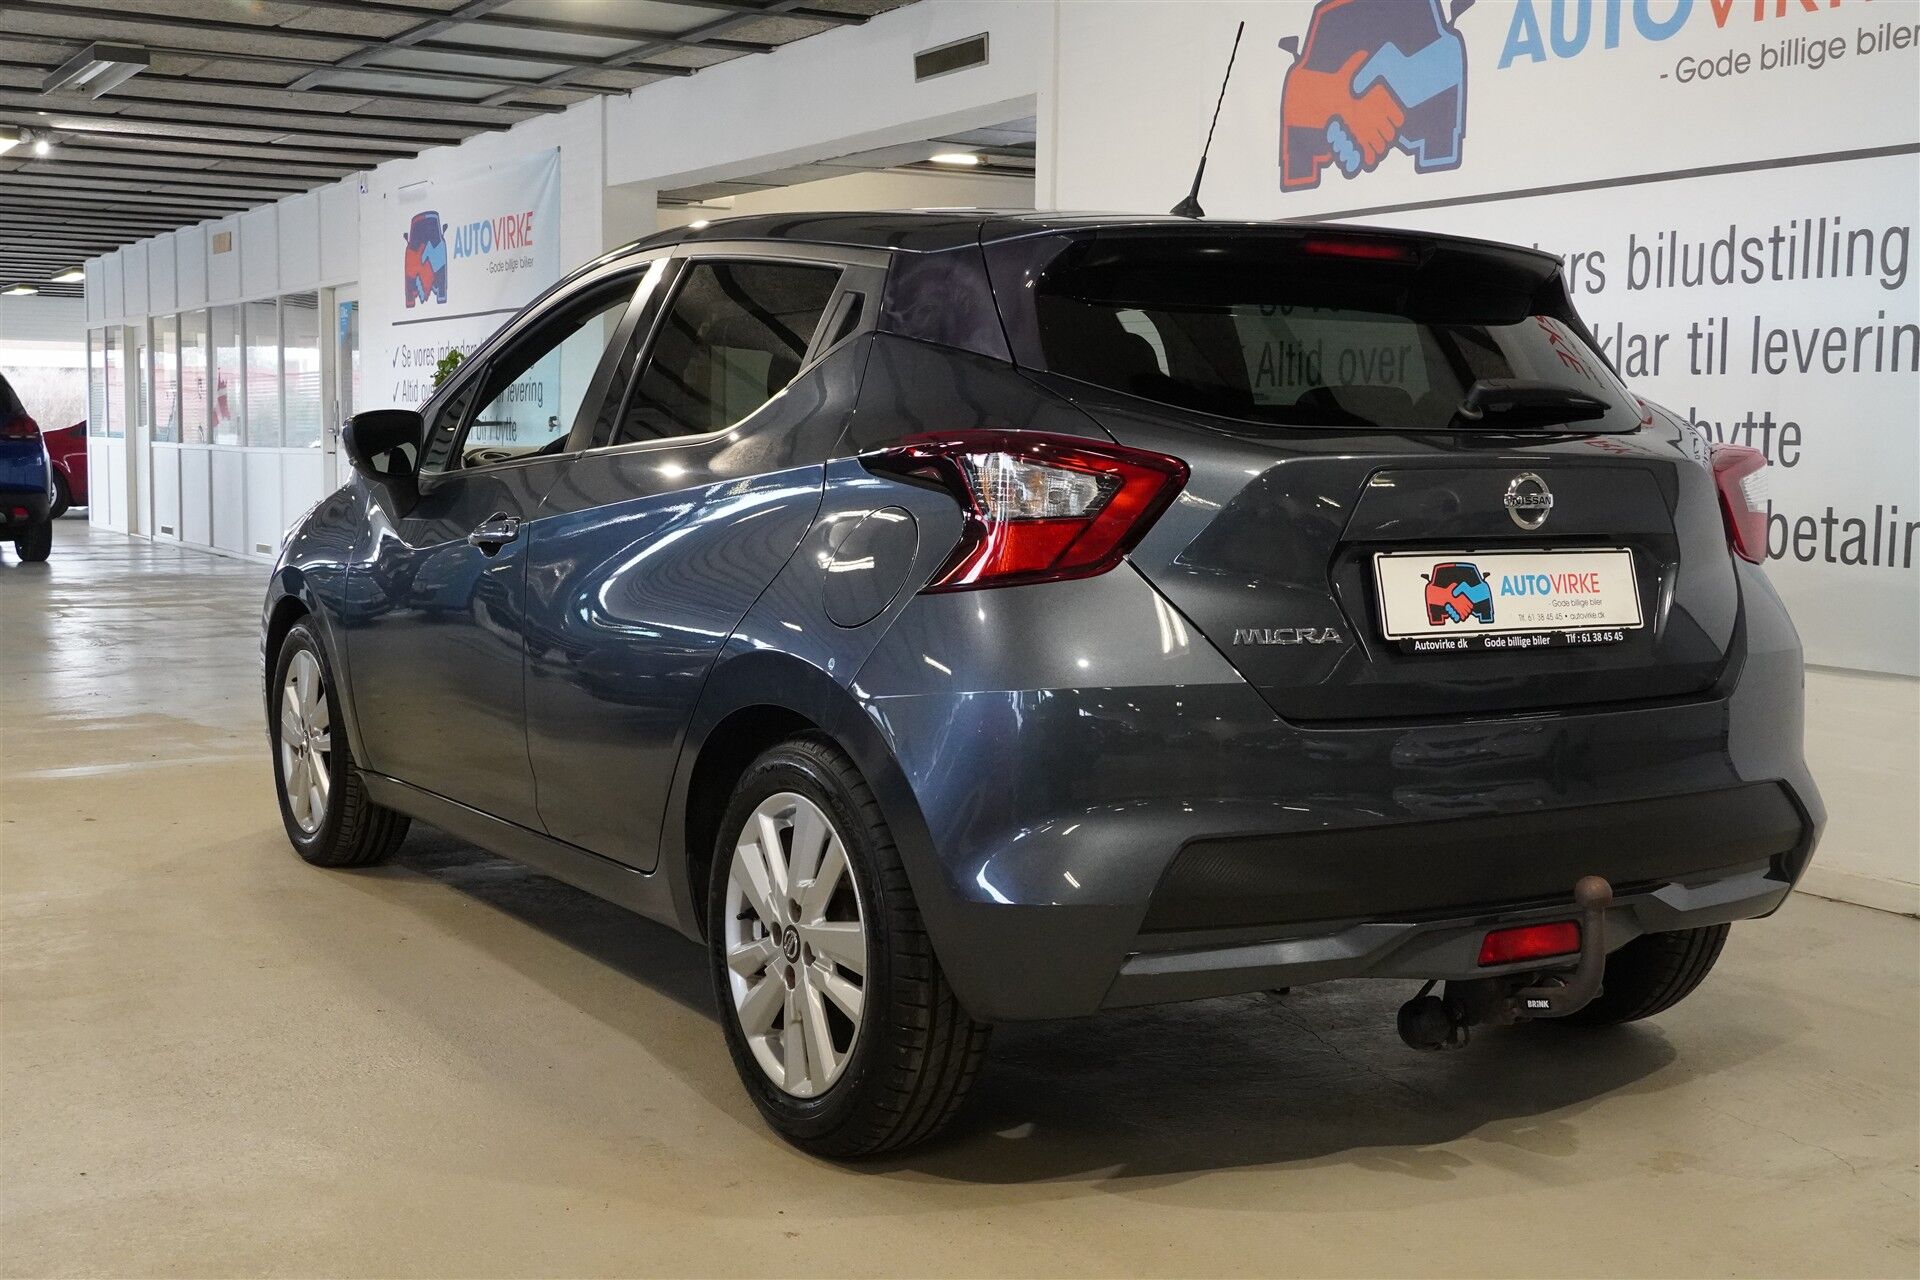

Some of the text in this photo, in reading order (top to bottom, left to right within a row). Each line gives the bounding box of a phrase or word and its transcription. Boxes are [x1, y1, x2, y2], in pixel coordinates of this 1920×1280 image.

[1675, 50, 1751, 83] Gode
[1760, 33, 1847, 70] billige
[1857, 22, 1920, 55] biler
[454, 211, 534, 259] AUTOVIRKE
[1627, 216, 1910, 291] biludstilling
[1687, 317, 1728, 376] til
[1751, 310, 1920, 375] leverin
[402, 344, 411, 367] Se
[413, 347, 434, 367] vores
[1255, 338, 1411, 387] Altid over
[402, 378, 418, 402] Altid
[1513, 496, 1551, 505] NISSAN
[1500, 573, 1601, 596] AUTOVIRKE
[1552, 599, 1570, 608] Gode
[1527, 613, 1535, 621] 61
[1537, 613, 1545, 621] 38
[1546, 613, 1554, 621] 45
[1555, 612, 1563, 620] 45
[1233, 627, 1343, 645] MICRA
[1414, 638, 1456, 650] Autovirke
[1457, 637, 1468, 649] dk
[1484, 636, 1506, 648] Gode
[1507, 635, 1531, 649] billige
[1532, 634, 1550, 646] biler
[1581, 632, 1591, 642] 61
[1593, 632, 1603, 642] 38
[1604, 632, 1613, 641] 45
[1614, 631, 1624, 641] 45
